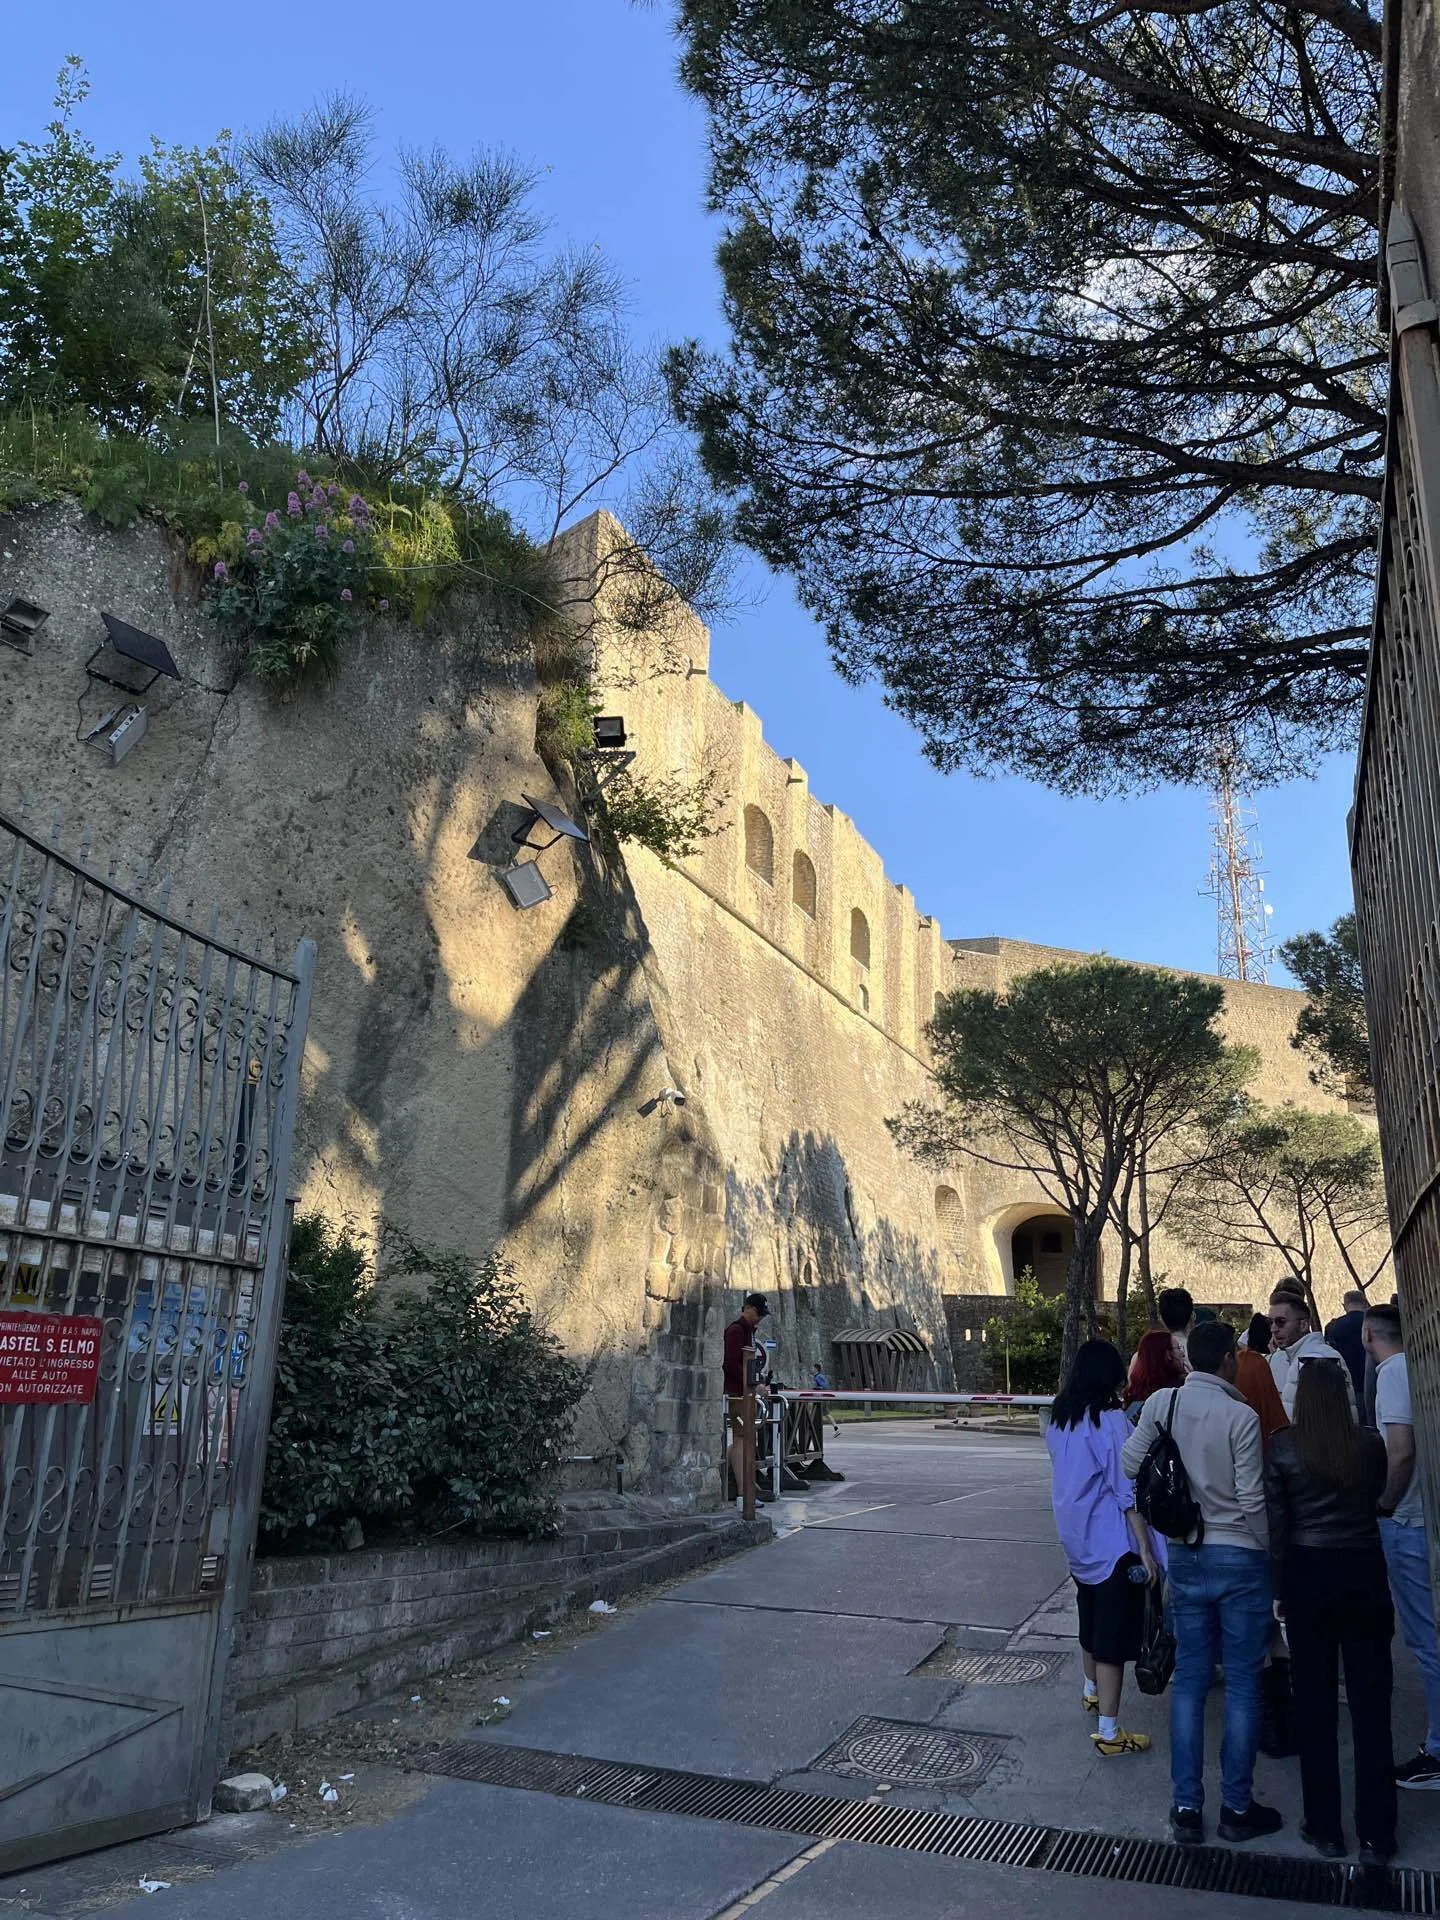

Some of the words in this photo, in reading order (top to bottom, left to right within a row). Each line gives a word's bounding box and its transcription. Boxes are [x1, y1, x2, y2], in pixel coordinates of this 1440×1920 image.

[0, 1322, 40, 1333] RINTENDENZA
[81, 1327, 101, 1336] NAPOLI
[0, 1335, 40, 1352] ASTEL
[11, 1370, 38, 1380] ALLE
[41, 1371, 68, 1381] AUTO
[17, 1383, 84, 1395] AUTORIZZATE
